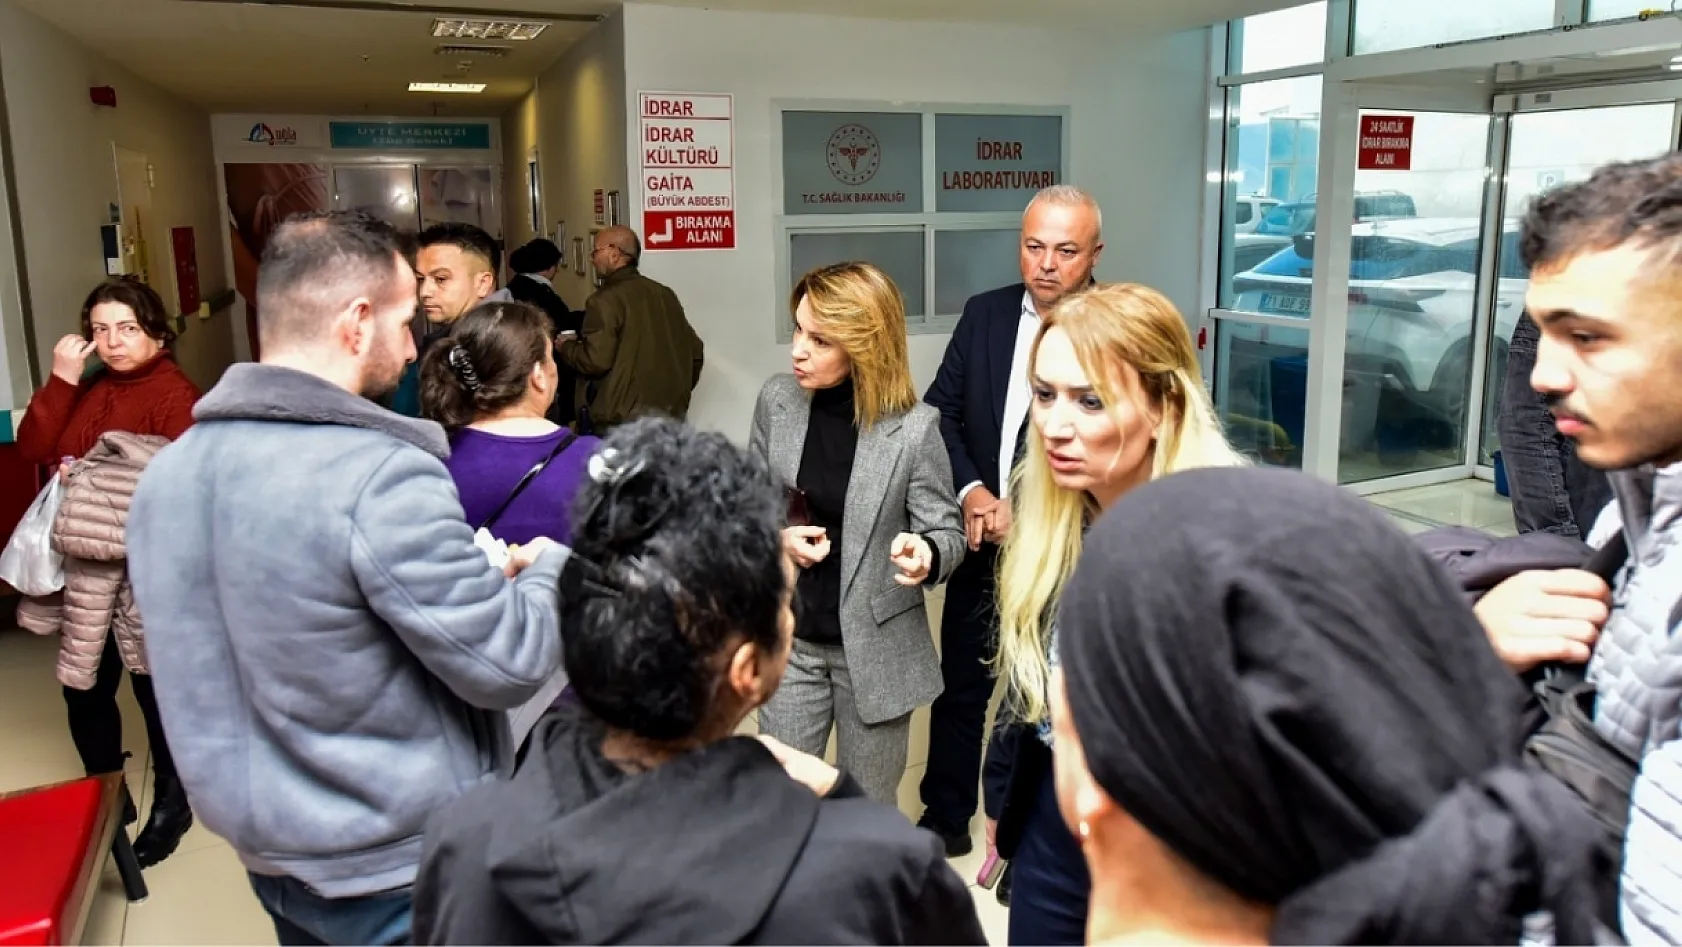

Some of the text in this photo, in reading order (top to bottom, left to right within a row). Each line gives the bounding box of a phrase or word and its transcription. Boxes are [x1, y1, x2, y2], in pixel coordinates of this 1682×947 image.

[644, 96, 694, 116] İDRAR
[645, 124, 695, 143] İDRAR
[646, 145, 718, 165] KÜLTÜRÜ
[977, 137, 1023, 160] İDRAR
[647, 172, 694, 191] GAİTA
[942, 170, 1055, 190] LABORATUVARI
[647, 194, 730, 208] (BÜYÜK ABDEST)
[802, 191, 905, 203] T.C. SAĞLIK BAKANLIĞI
[676, 216, 732, 230] BIRAKMA
[686, 229, 723, 244] ALANI
